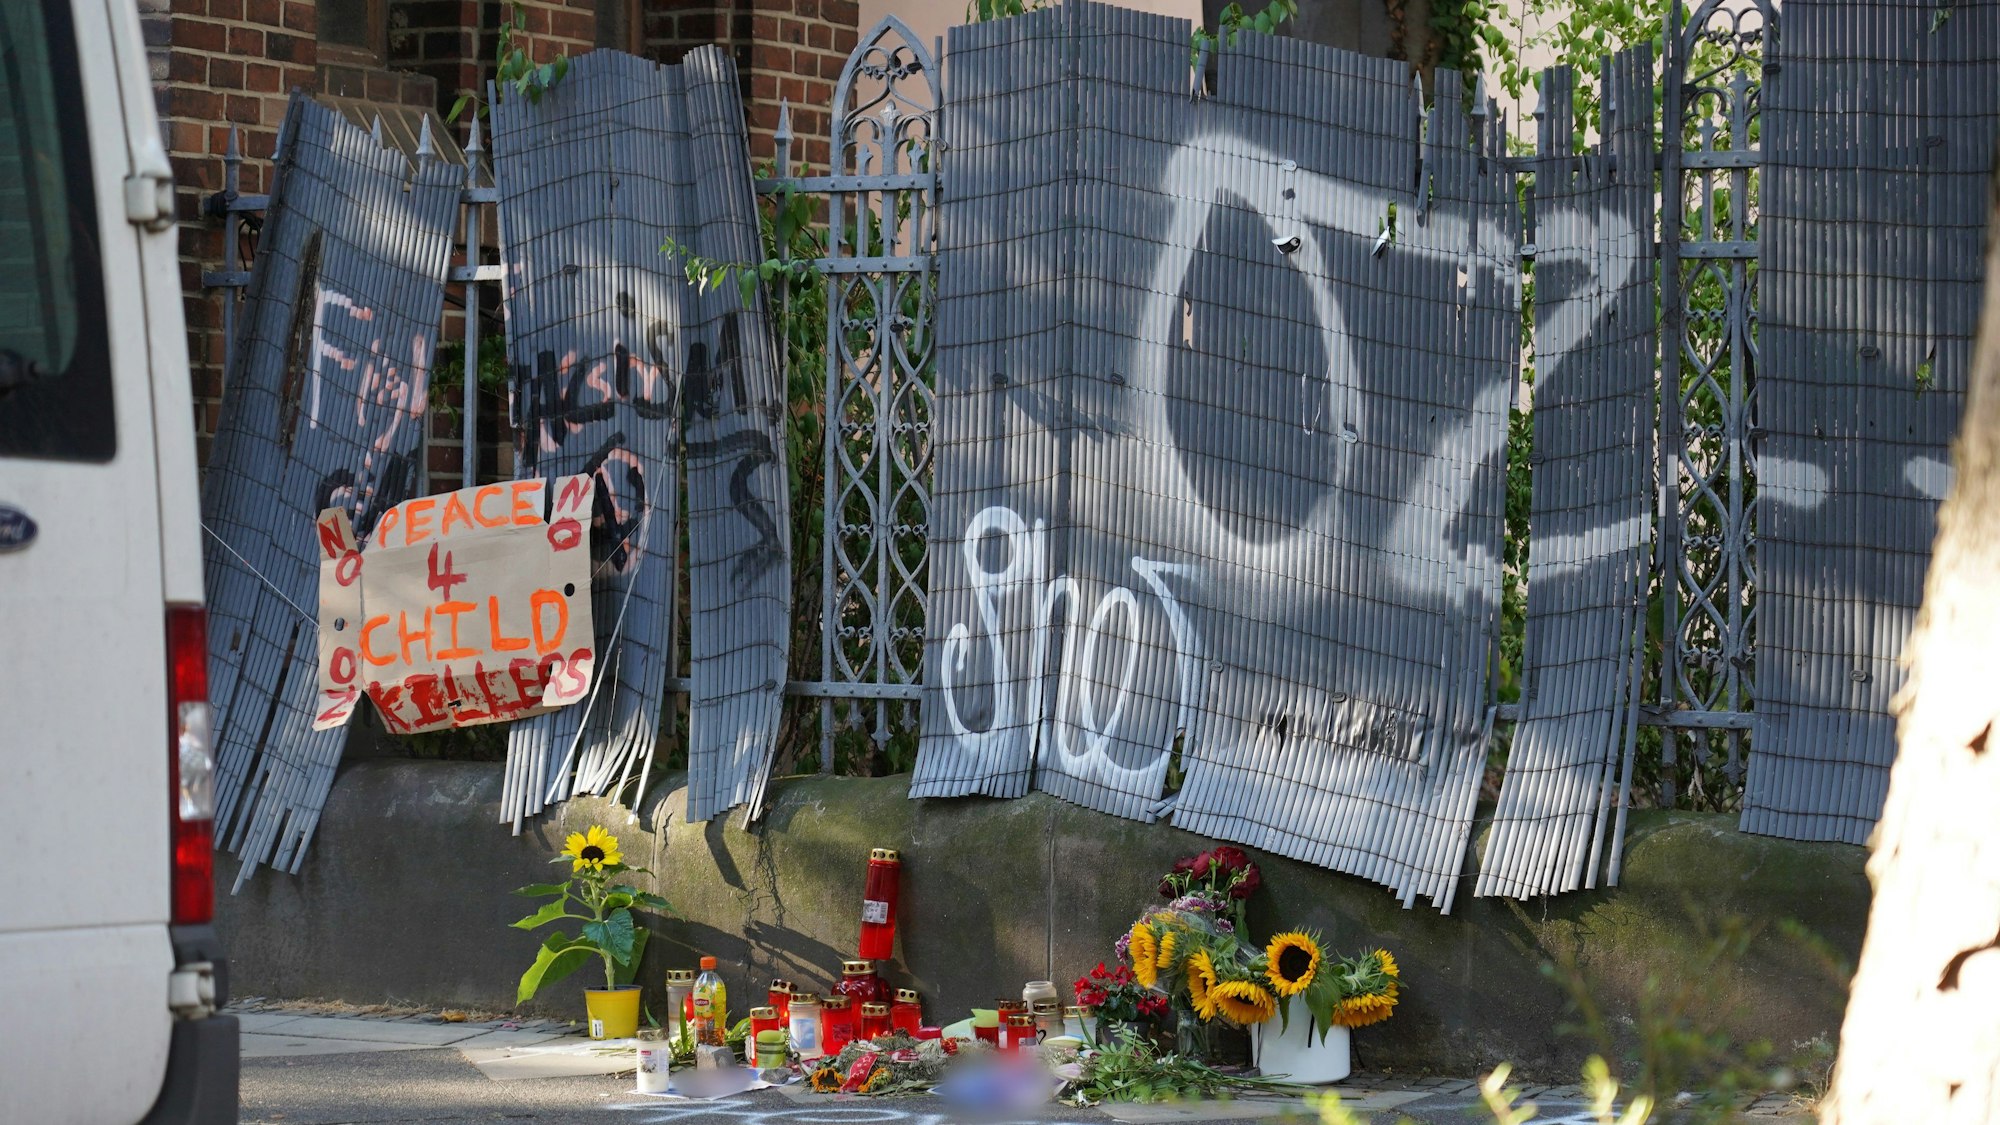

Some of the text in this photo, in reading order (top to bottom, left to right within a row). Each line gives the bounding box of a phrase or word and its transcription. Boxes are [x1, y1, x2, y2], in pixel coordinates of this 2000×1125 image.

[377, 482, 543, 548] PEACE
[427, 541, 468, 601] 4
[358, 588, 569, 666] CHILD
